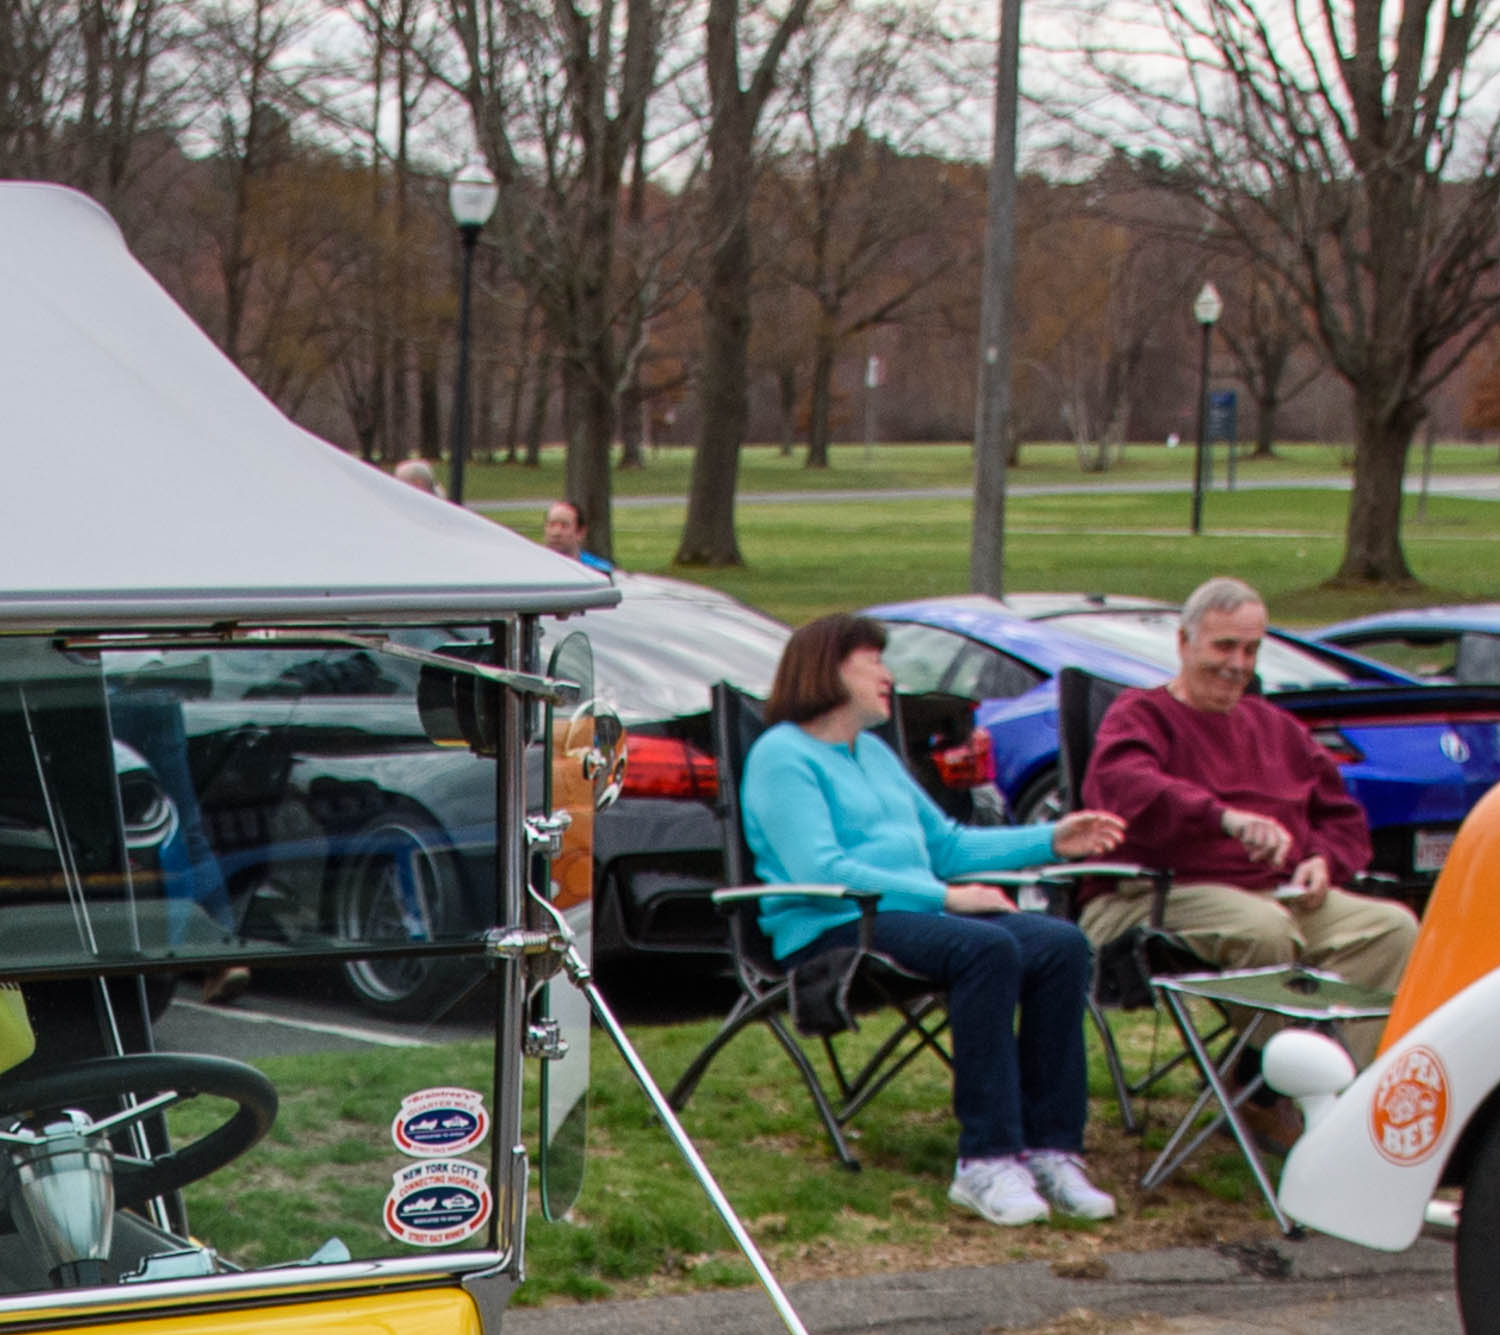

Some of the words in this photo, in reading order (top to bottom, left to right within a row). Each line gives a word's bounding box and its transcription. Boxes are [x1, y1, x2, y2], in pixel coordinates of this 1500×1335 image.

[1379, 1052, 1442, 1107] SUPER
[1383, 1116, 1436, 1157] BEE
[403, 1167, 422, 1180] NEW
[426, 1163, 448, 1174] YORK
[451, 1164, 478, 1180] CITY'S
